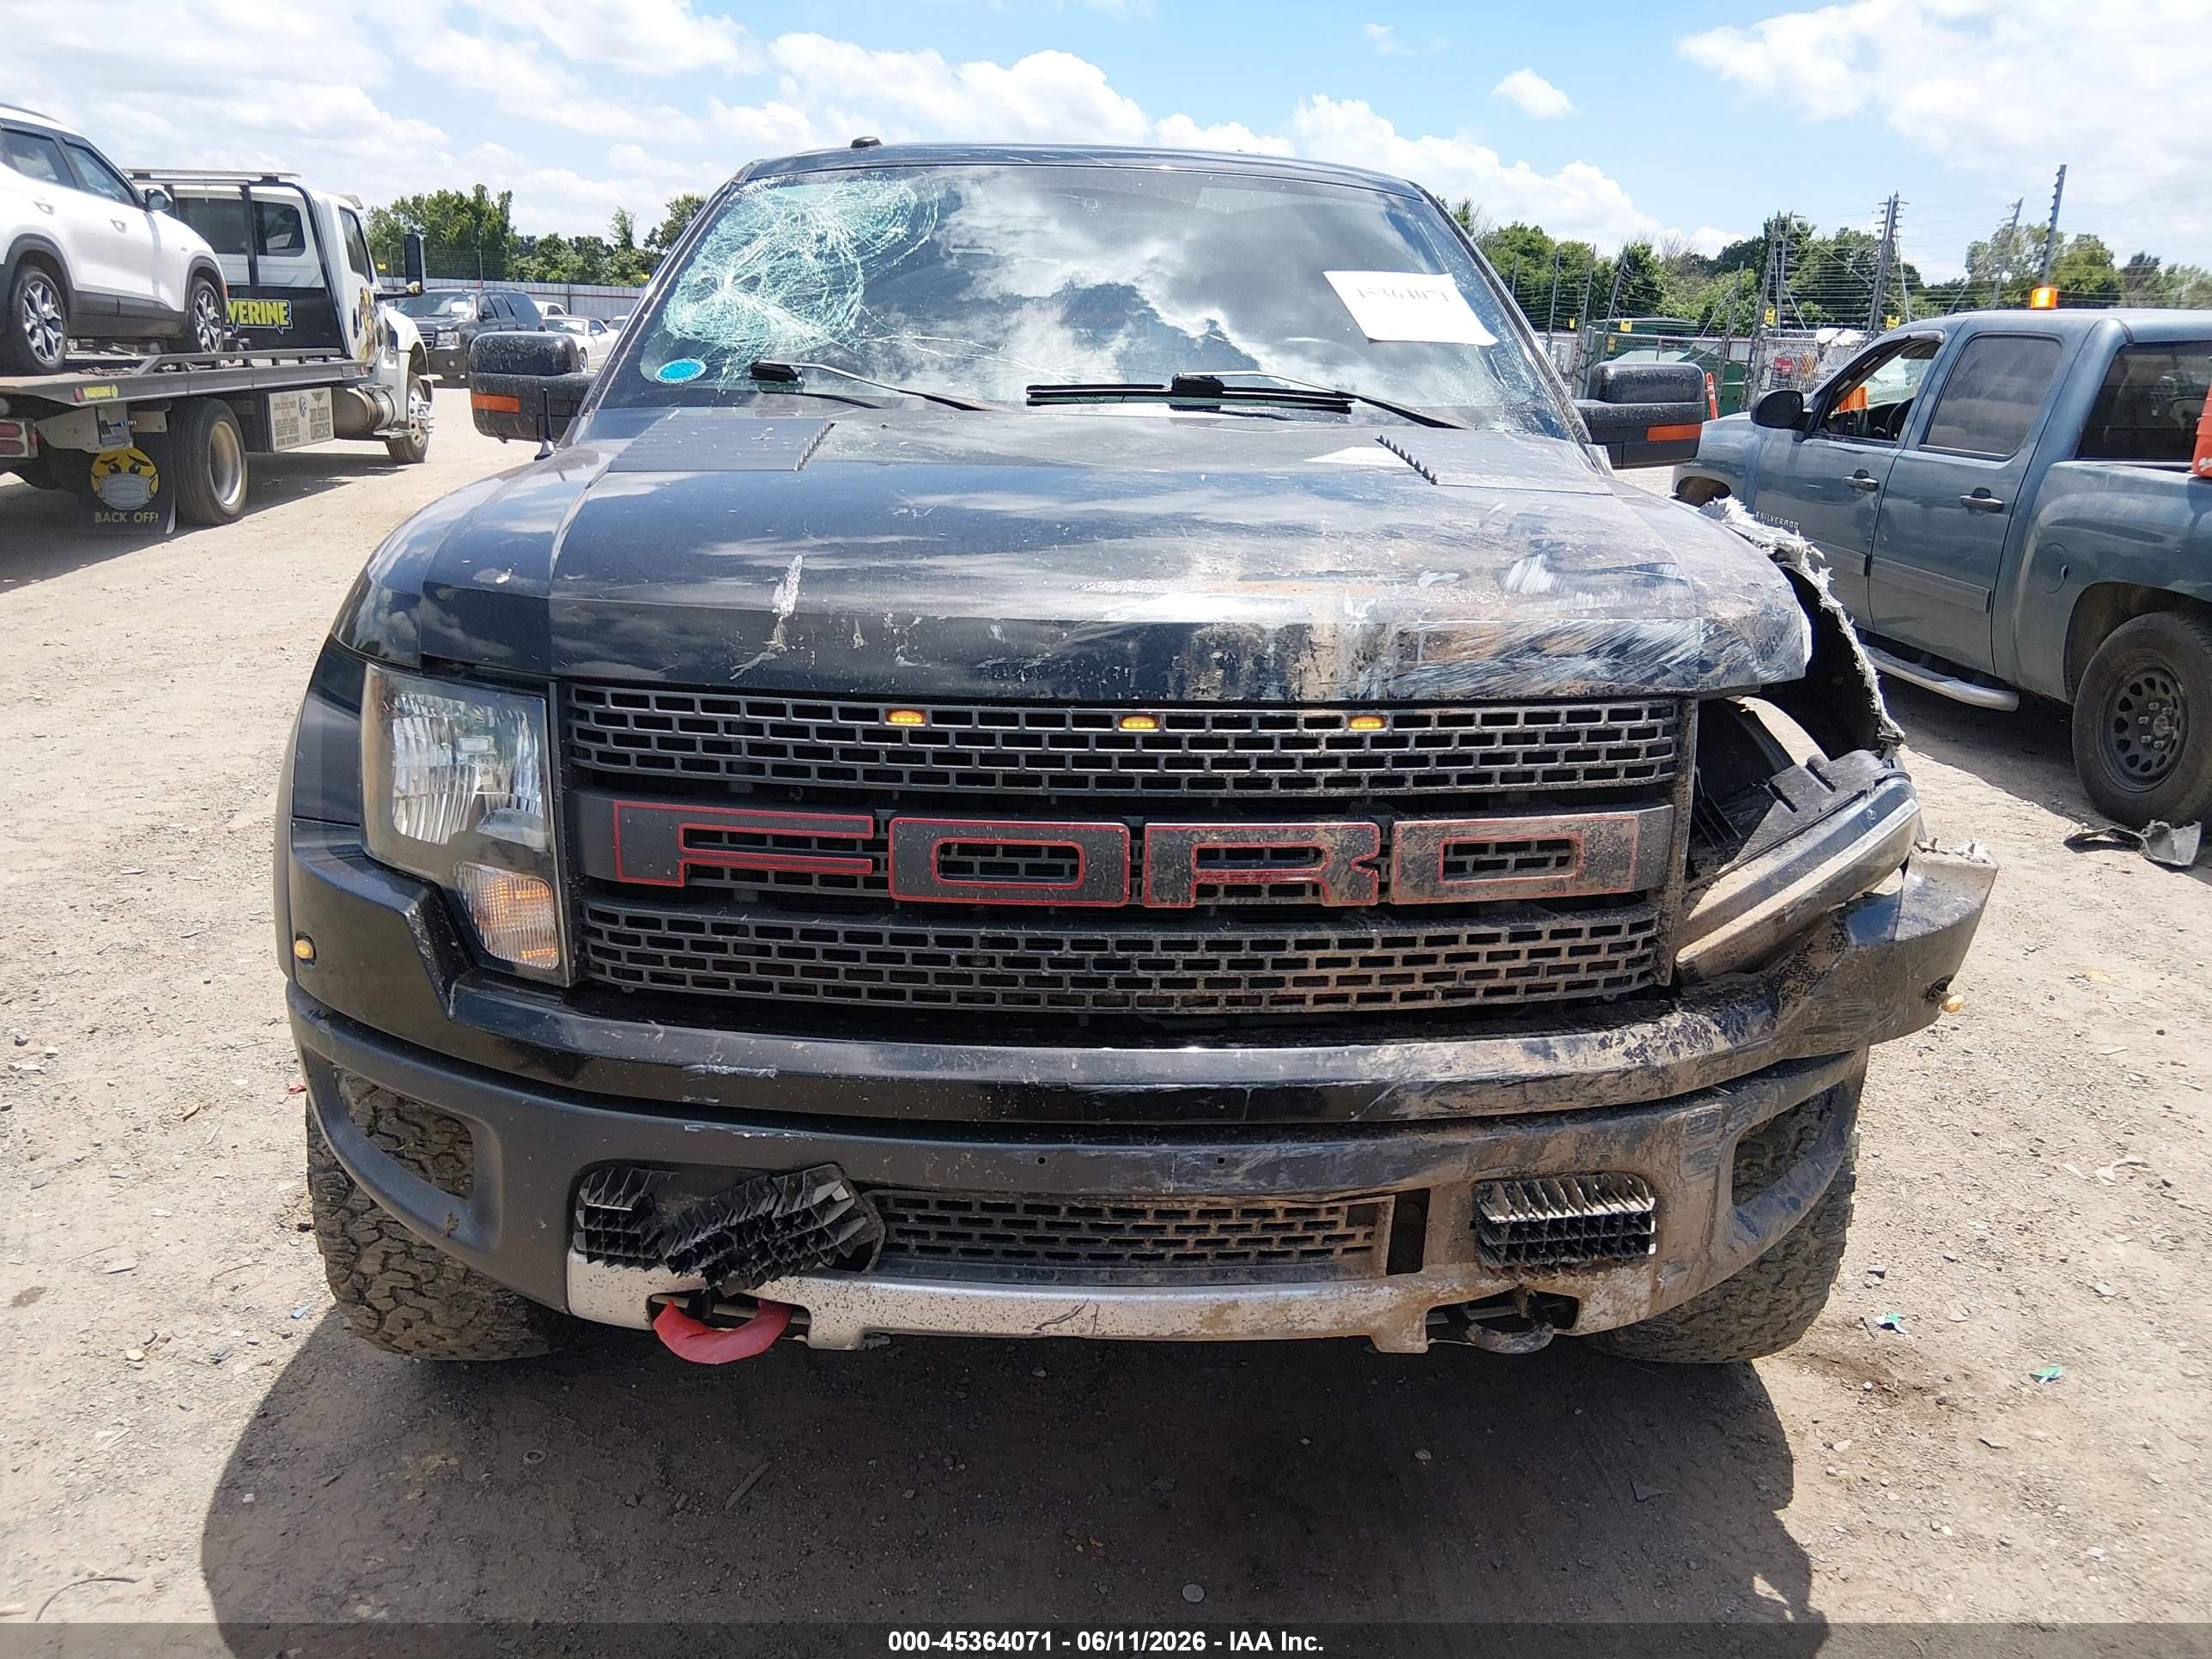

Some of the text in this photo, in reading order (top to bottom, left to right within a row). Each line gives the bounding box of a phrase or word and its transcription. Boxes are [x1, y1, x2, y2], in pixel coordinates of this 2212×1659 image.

[94, 511, 159, 523] BACK OFF!
[1760, 512, 1799, 529] SILVERADO
[613, 799, 1639, 906] FORD
